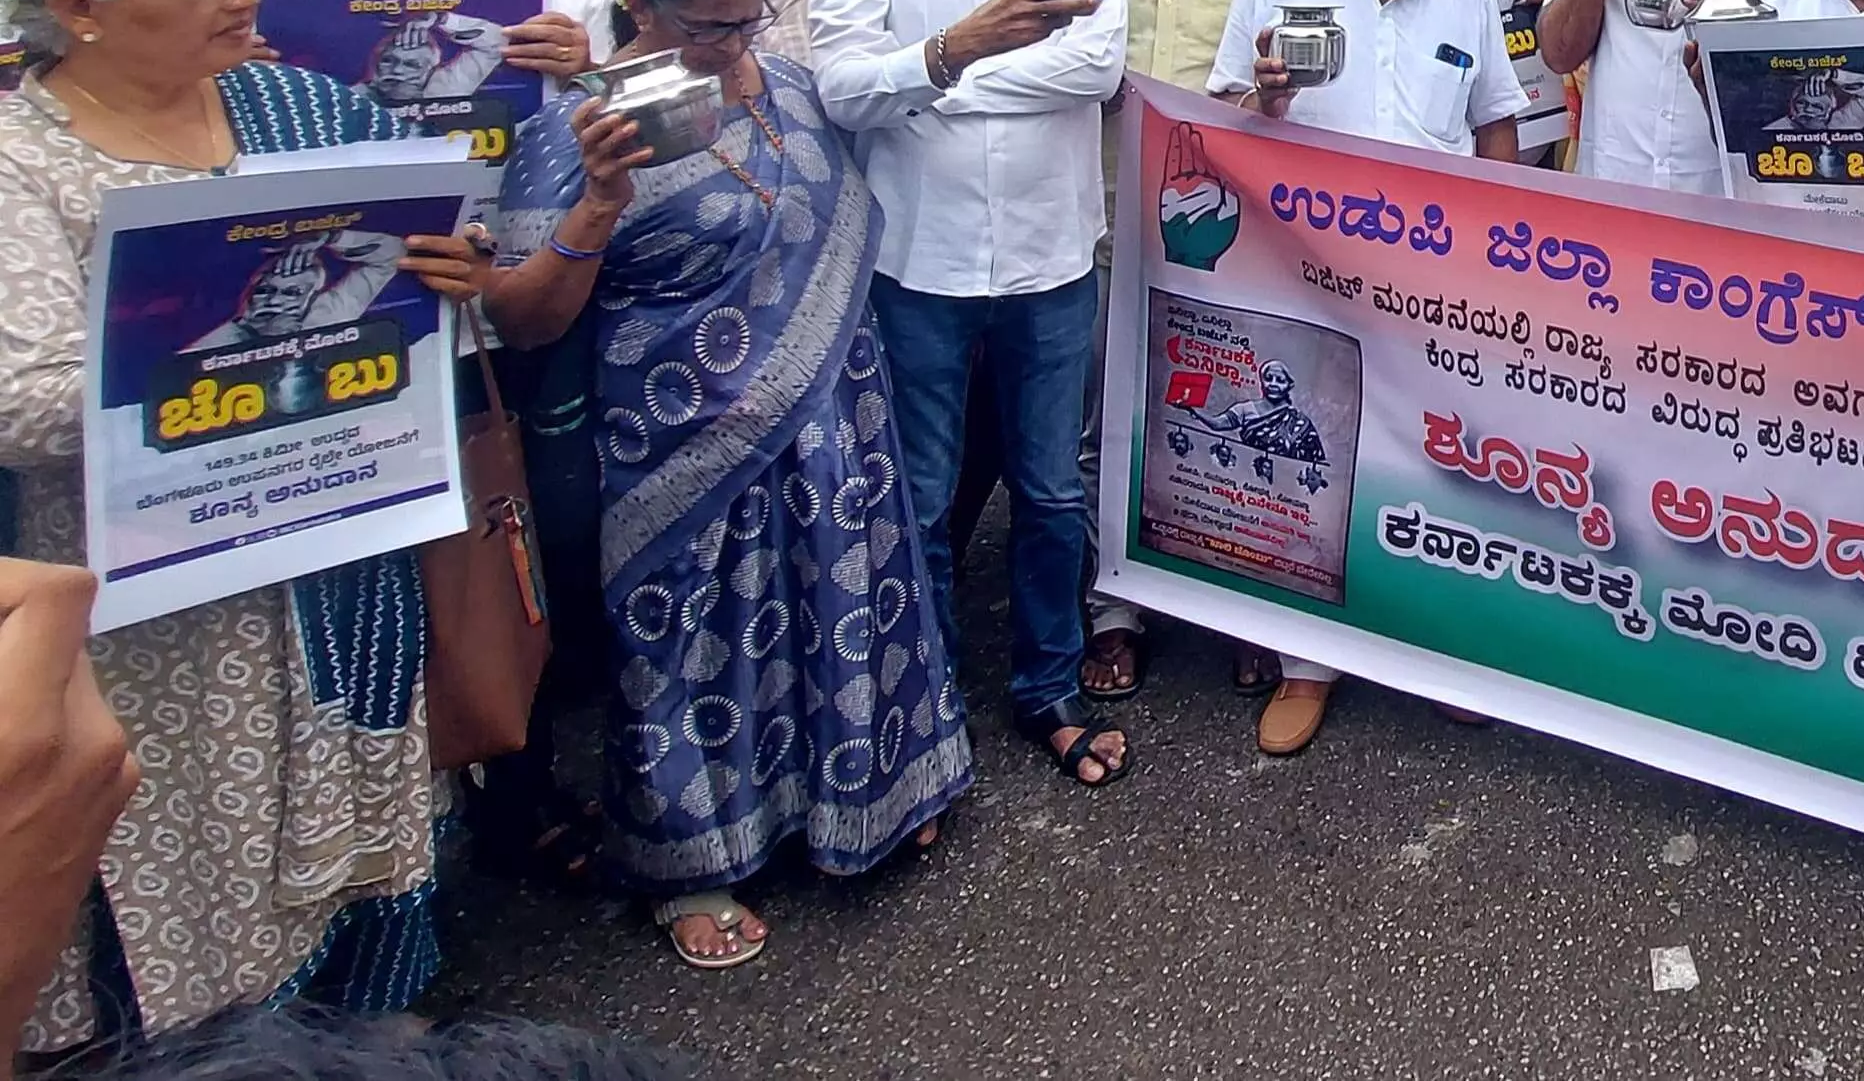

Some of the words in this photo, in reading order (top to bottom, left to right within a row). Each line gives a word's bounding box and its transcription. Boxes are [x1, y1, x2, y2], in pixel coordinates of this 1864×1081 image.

[1770, 56, 1806, 70] ಕೇಂದ್ರ
[1807, 54, 1848, 67] ಬಜೆಟ್
[425, 101, 472, 116] ಮೋದಿ
[1776, 132, 1832, 145] ಕರ್ನಾಟಕಕ್ಕೆ
[1831, 131, 1864, 142] ಮೋದಿ
[226, 219, 289, 242] ಕೇಂದ್ರ
[294, 211, 363, 233] ಬಜೆಟ್
[1270, 182, 1453, 256] ಉಡುಪಿ
[1487, 221, 1620, 314] ಜಿಲ್ಲಾ
[202, 339, 304, 371] ಕರ್ನಾಟಕಕ್ಕೆ
[304, 326, 359, 351] ಮೋದಿ
[1184, 338, 1258, 373] ಕರ್ನಾಟಕಕ್ಕೆ
[1373, 282, 1536, 360] ಮಂಡನೆಯಲ್ಲಿ
[1545, 321, 1613, 380] ರಾಜ್ಯ
[1636, 340, 1766, 396] ಸರಕಾರದ
[1504, 359, 1627, 415] ಸರಕಾರದ
[1651, 392, 1748, 463] ವಿರುದ್ಧ
[227, 459, 305, 489] ಉಪನಗರ
[346, 429, 420, 458] ಯೋಜನೆಗೆ
[1423, 410, 1612, 547] ಶೂನ್ಯ
[188, 491, 260, 525] ಶೂನ್ಯ
[265, 460, 379, 505] ಅನುದಾನ
[1384, 508, 1648, 635] ಕರ್ನಾಟಕಕ್ಕೆ
[1667, 594, 1818, 663] ಮೋದಿ
